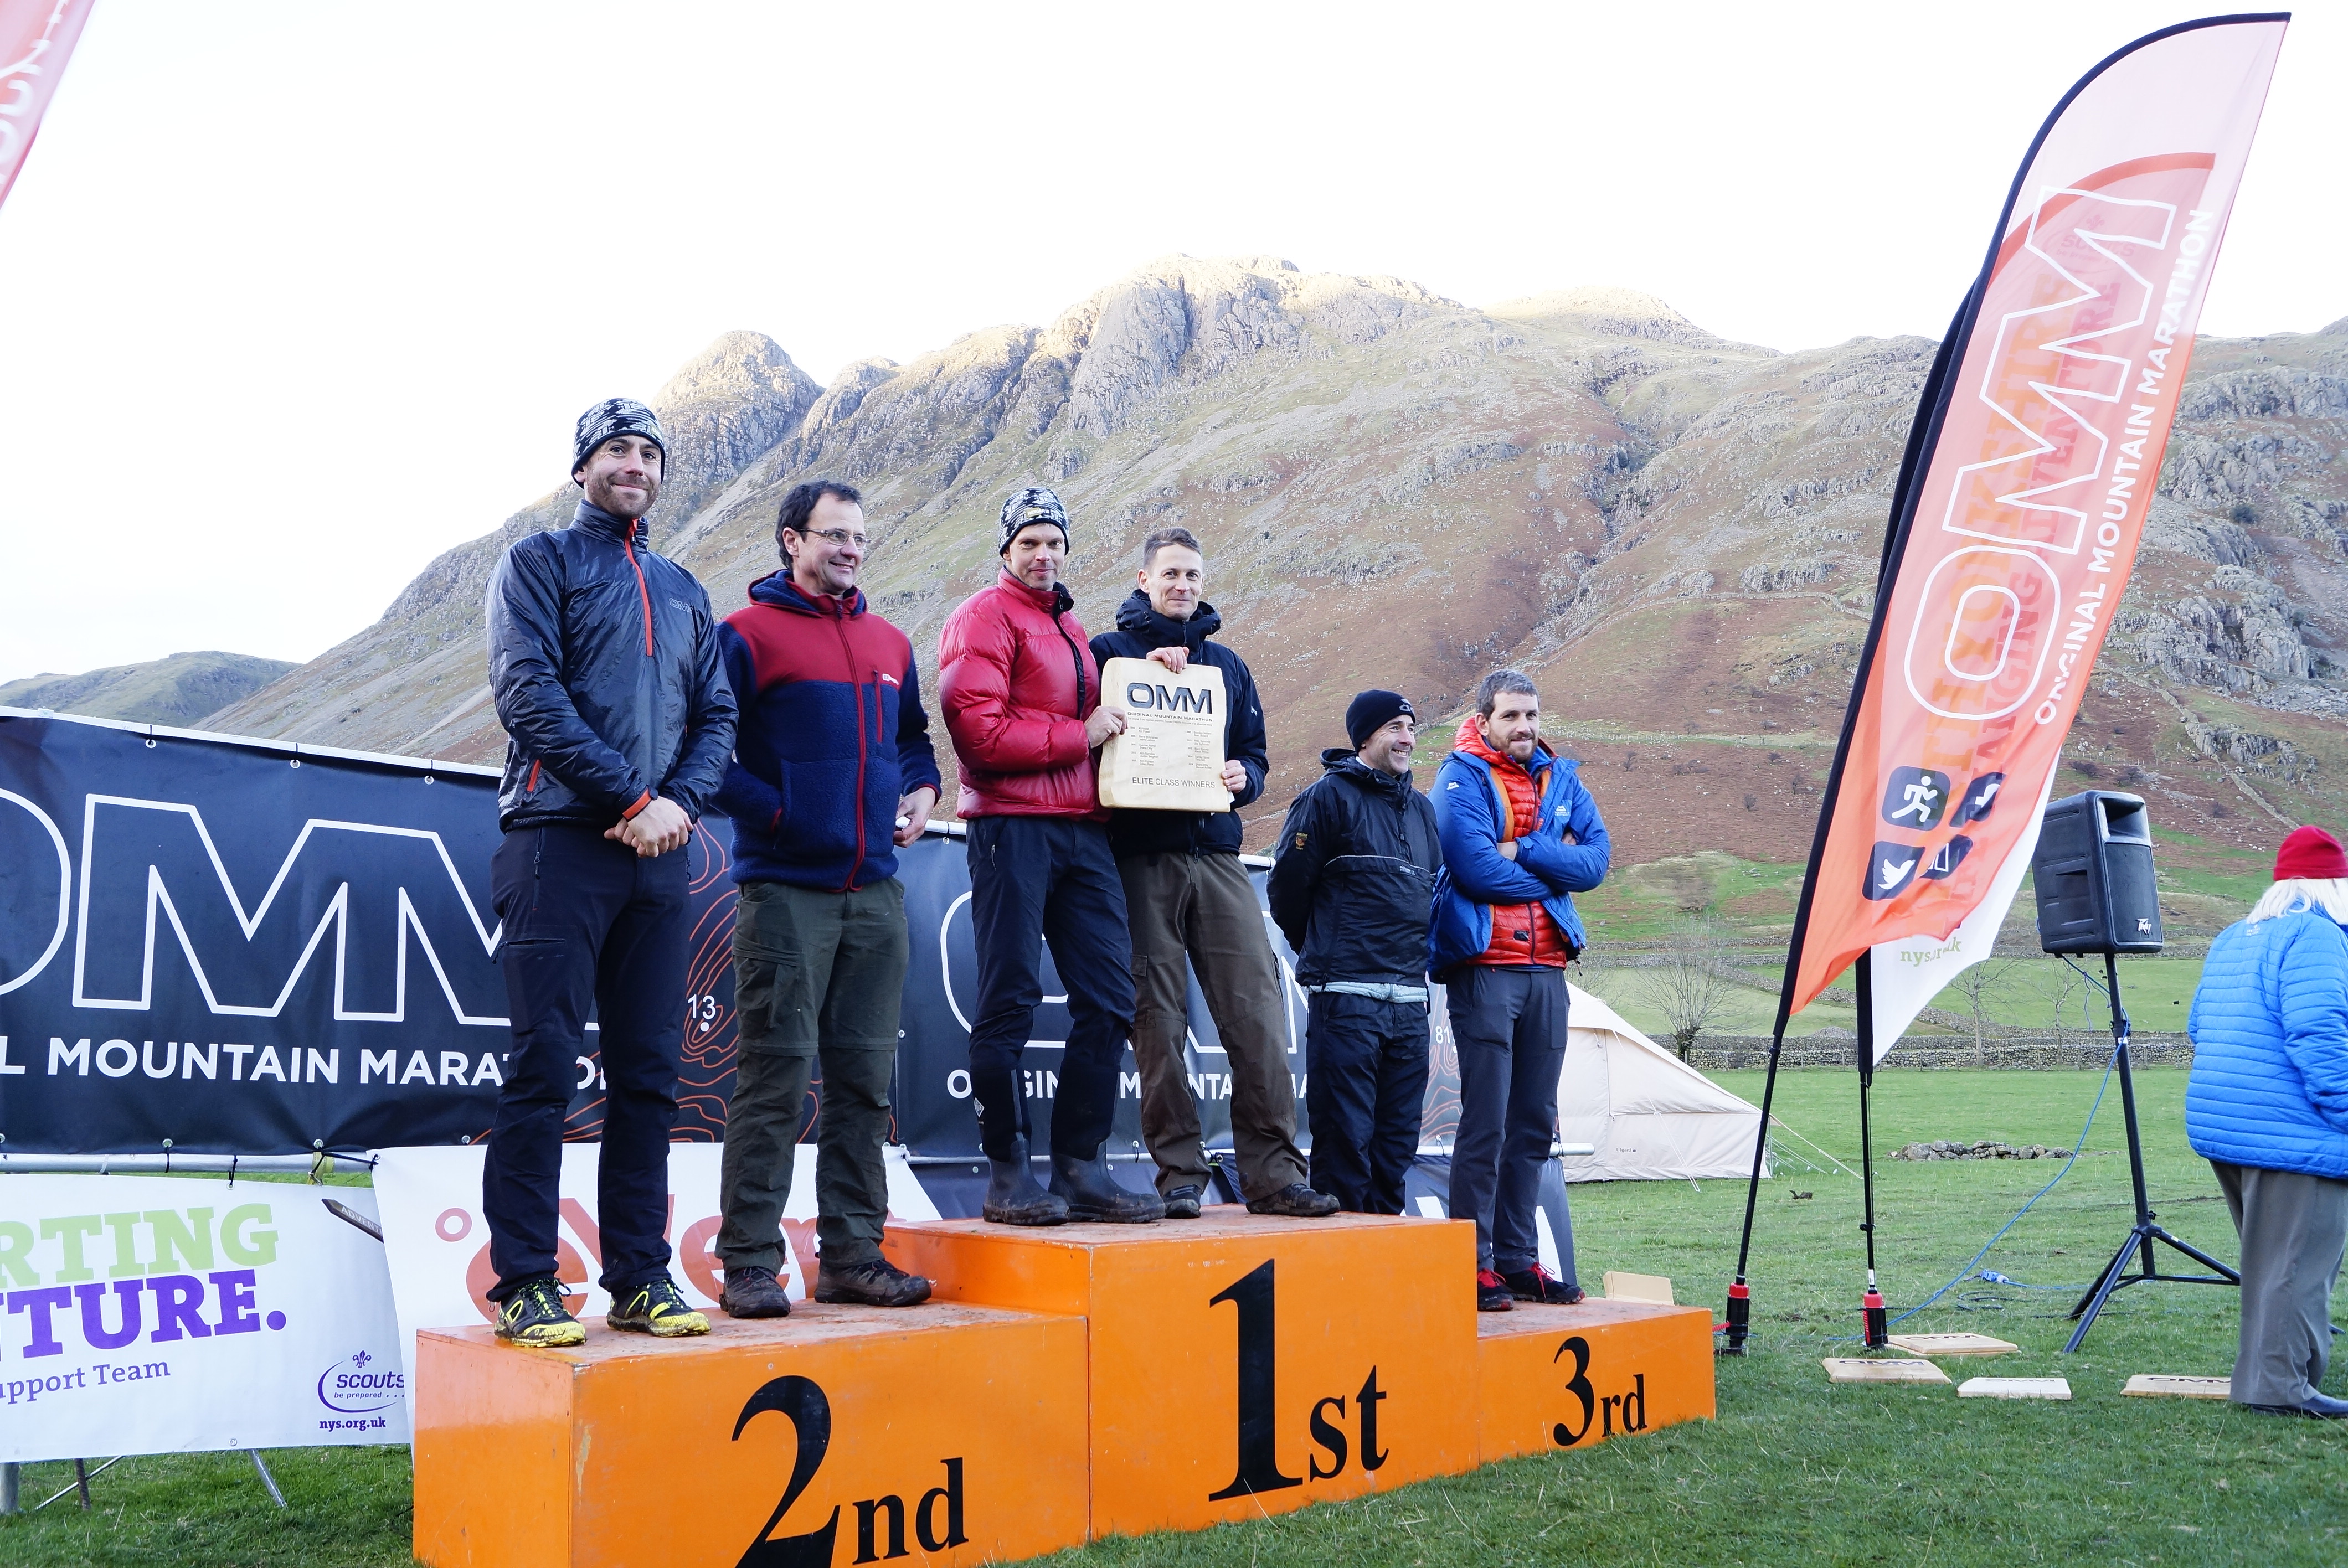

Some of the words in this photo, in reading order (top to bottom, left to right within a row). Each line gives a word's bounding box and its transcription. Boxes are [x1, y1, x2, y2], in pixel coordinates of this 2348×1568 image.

[2087, 403, 2156, 576] MOUNTAIN
[2140, 209, 2214, 396] MARATHON
[1903, 185, 2178, 721] OMM
[1127, 682, 1213, 714] OMM
[1132, 777, 1154, 785] ELITE
[1181, 780, 1215, 788] WINNERS
[688, 995, 715, 1020] 13
[1435, 1025, 1455, 1044] 81
[48, 1037, 339, 1084] MOUNTAIN
[341, 1205, 383, 1236] ADVENT
[92, 1361, 171, 1385] Team
[1209, 1258, 1390, 1502] 1st
[1552, 1335, 1648, 1447] 3rd
[319, 1416, 387, 1432] nys.org.uk
[730, 1374, 970, 1568] 2nd
